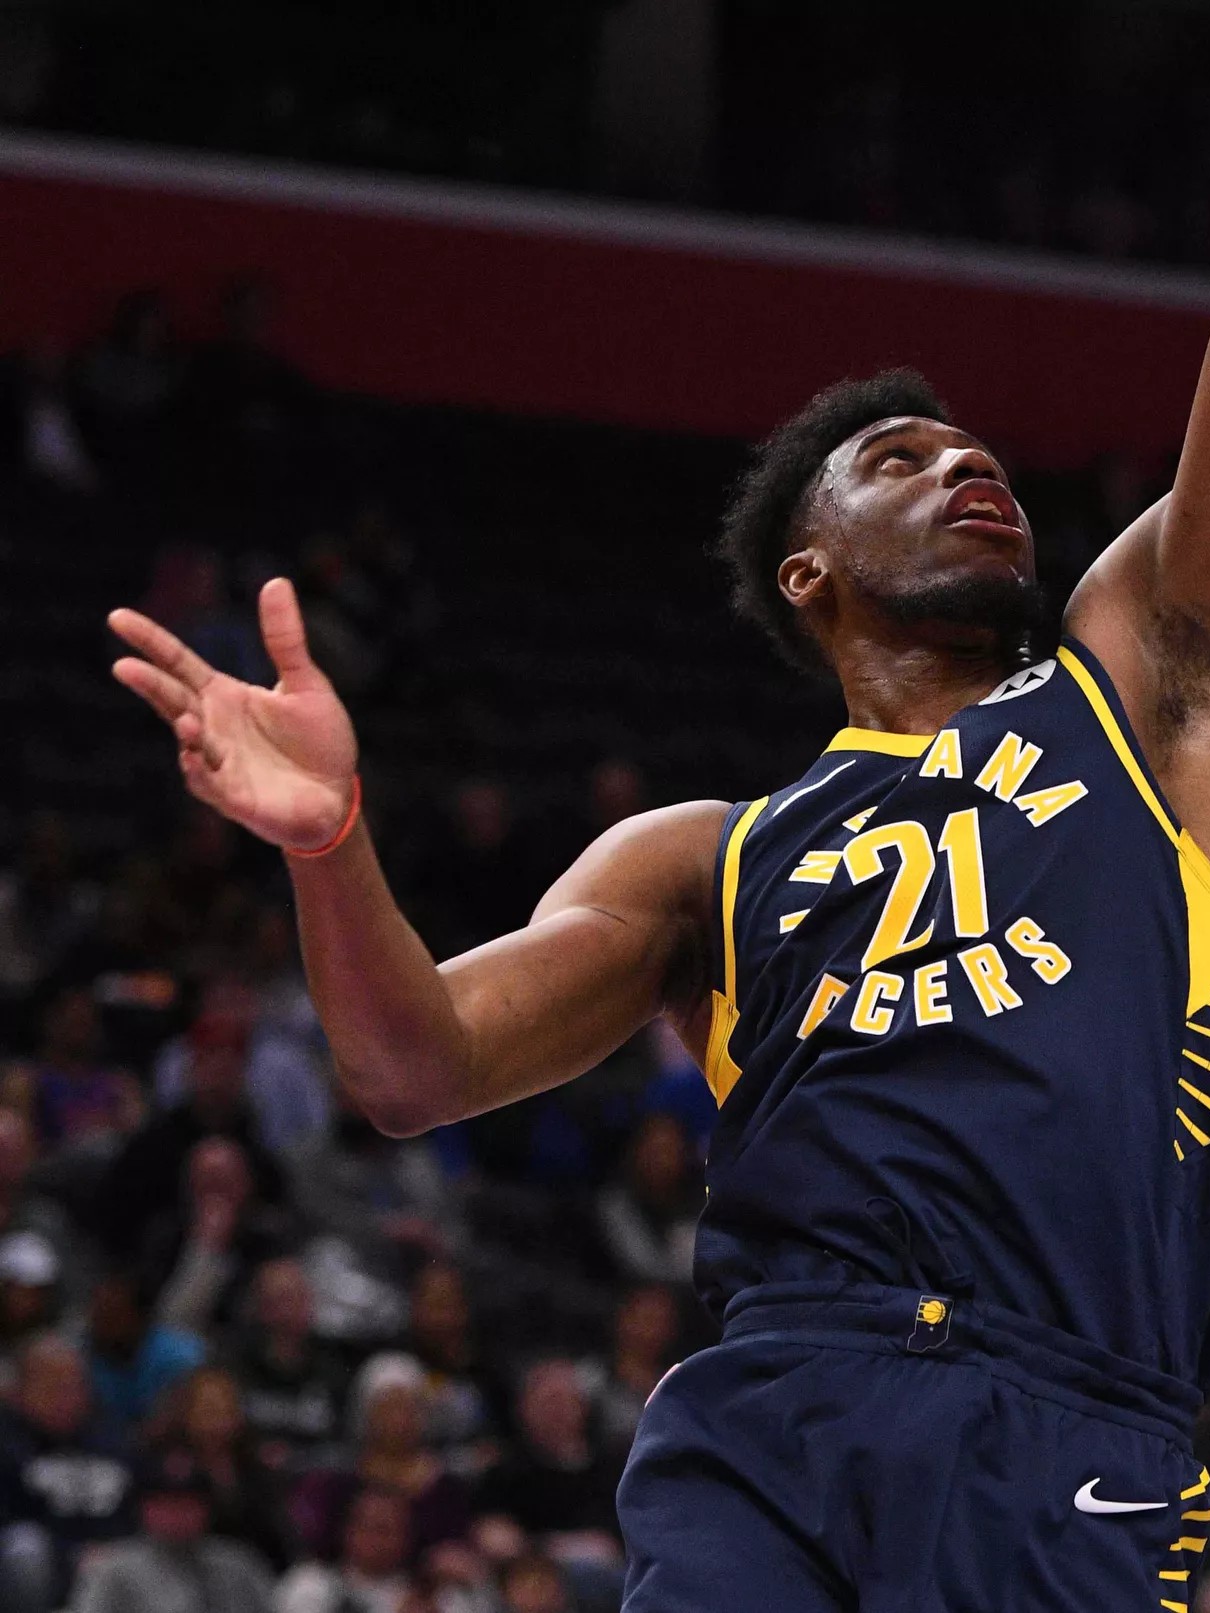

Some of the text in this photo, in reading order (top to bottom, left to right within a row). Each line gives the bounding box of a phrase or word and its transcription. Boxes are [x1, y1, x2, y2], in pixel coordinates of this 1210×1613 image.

[779, 729, 1089, 934] NANA
[842, 807, 989, 974] 21
[797, 916, 1072, 1041] PCERS
